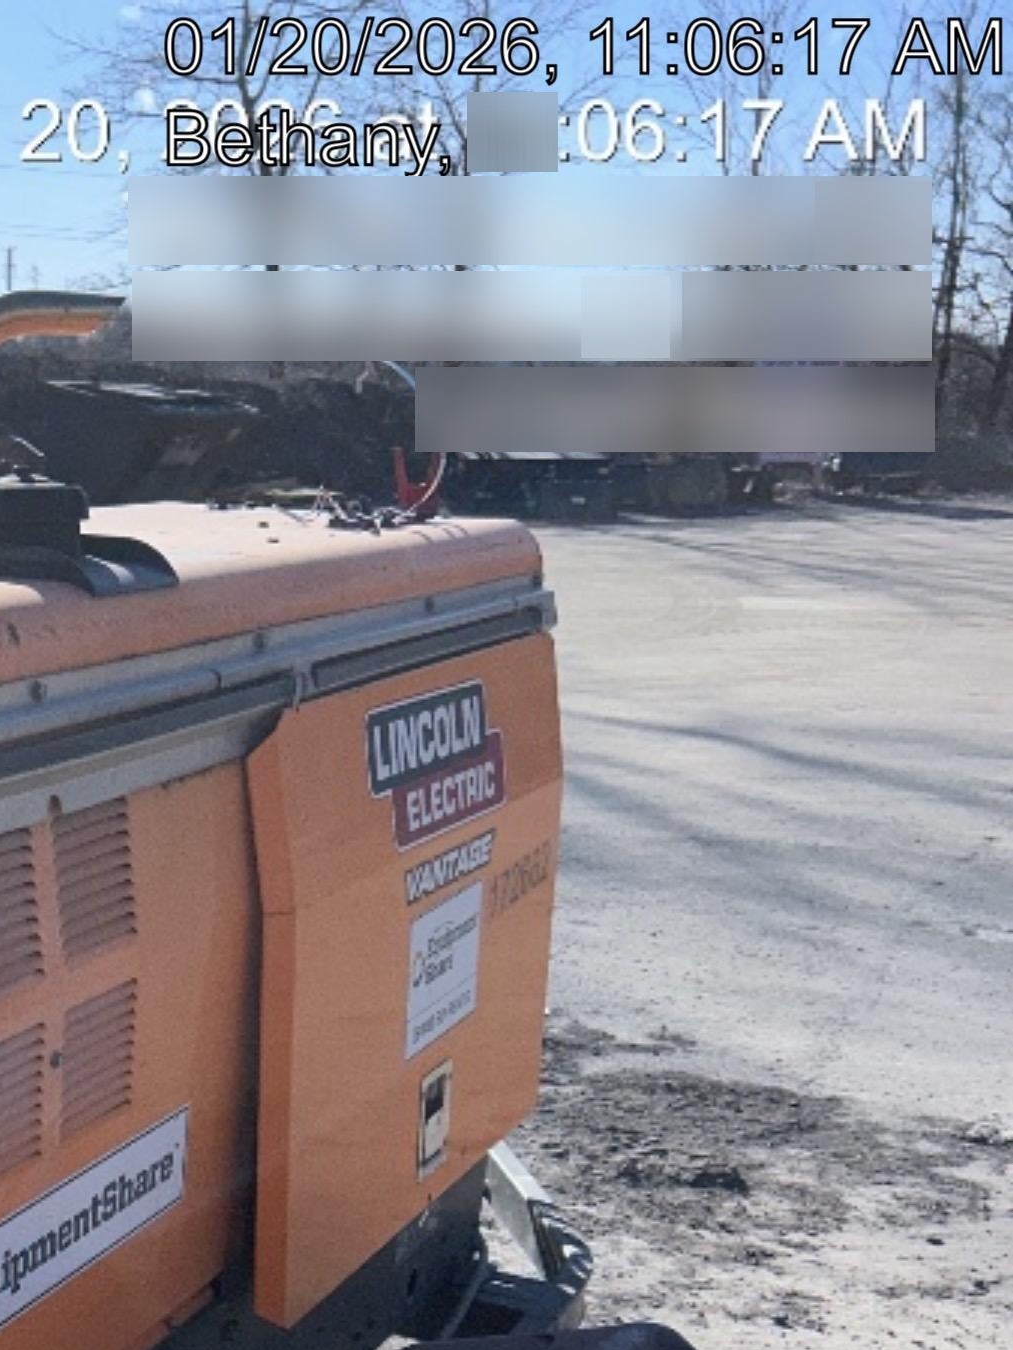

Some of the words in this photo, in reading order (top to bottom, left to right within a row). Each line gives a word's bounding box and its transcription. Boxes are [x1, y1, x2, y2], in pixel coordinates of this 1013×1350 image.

[373, 695, 482, 782] LINCOLN
[406, 761, 496, 832] ELECTRIC
[406, 830, 495, 904] VANTAGE
